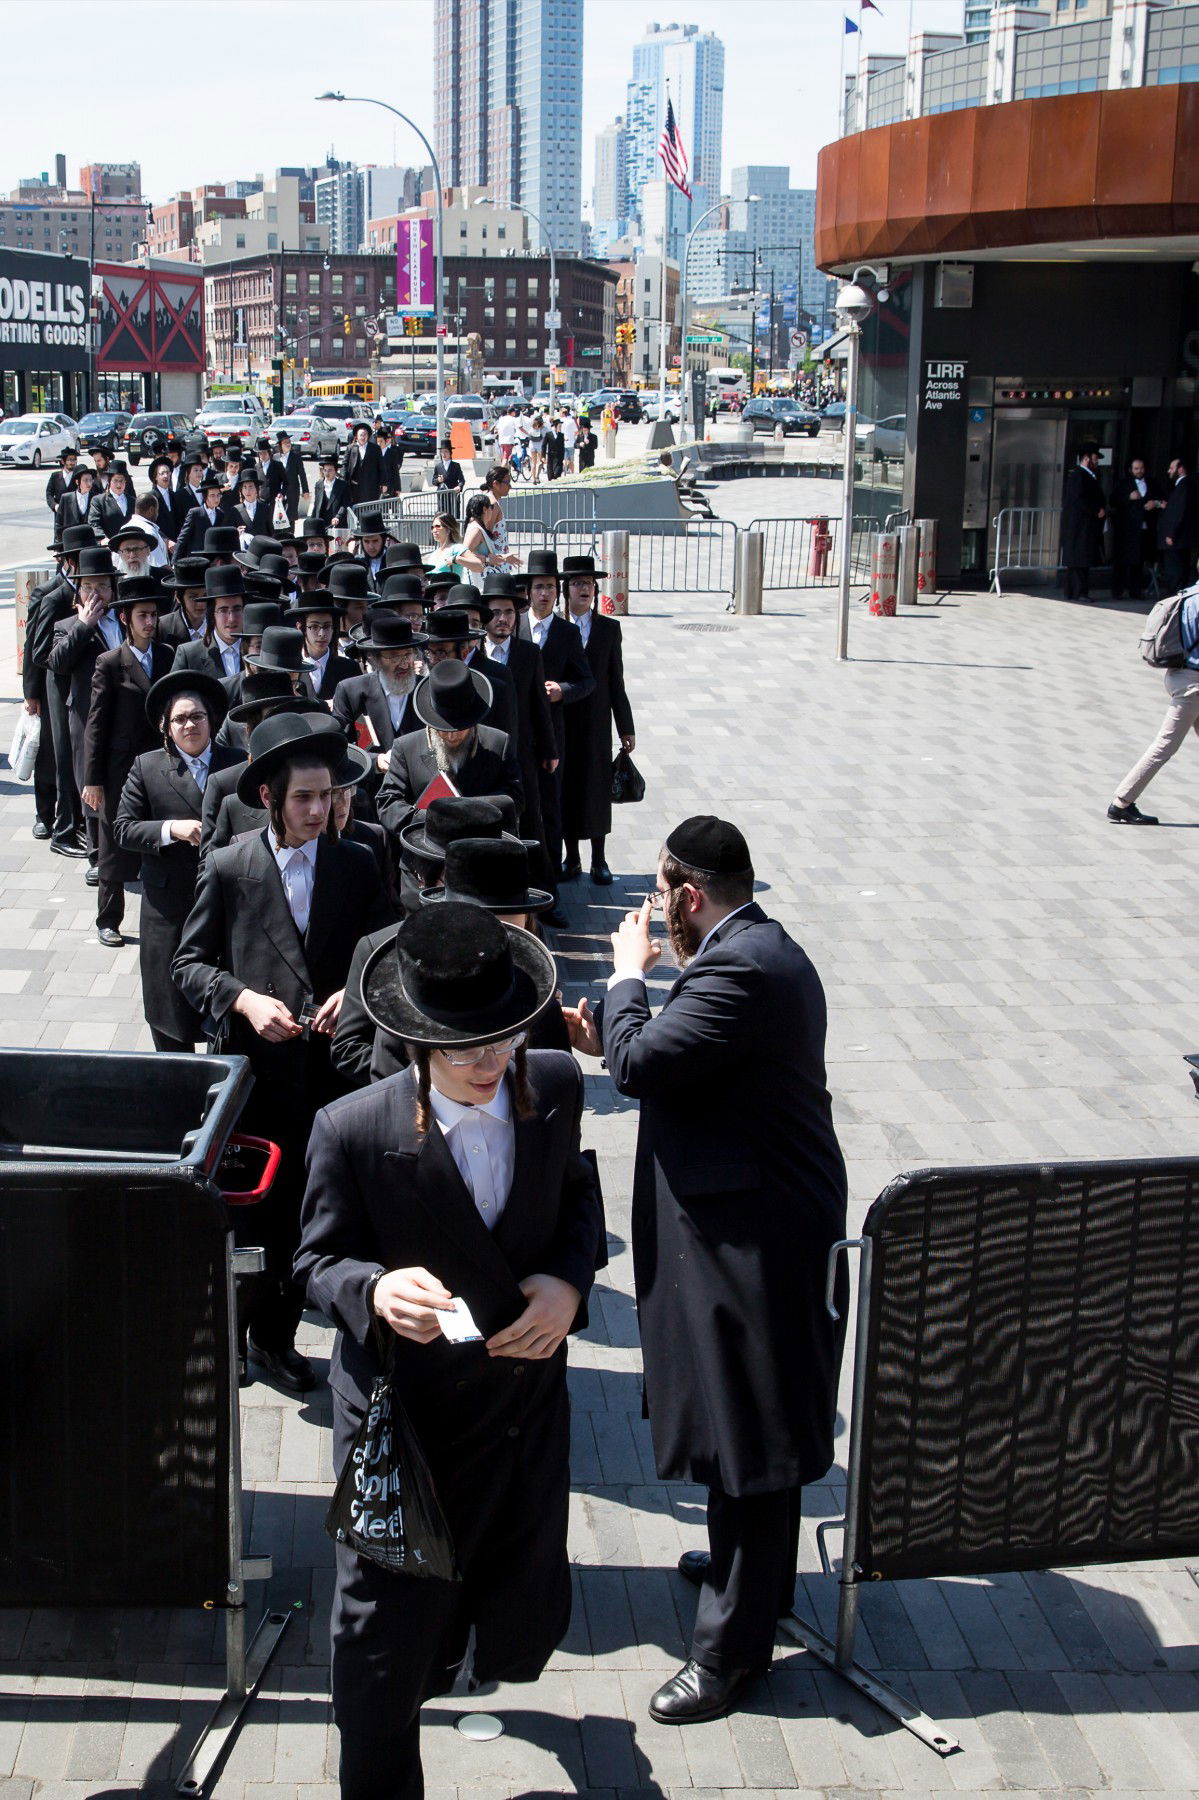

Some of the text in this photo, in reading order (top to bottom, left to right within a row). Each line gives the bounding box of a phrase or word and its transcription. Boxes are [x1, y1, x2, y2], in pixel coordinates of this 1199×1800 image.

[0, 322, 86, 346] RTING GOODS
[927, 363, 964, 378] LIRR
[926, 380, 959, 389] Across
[925, 390, 961, 400] Atlantic
[925, 400, 943, 409] Ave
